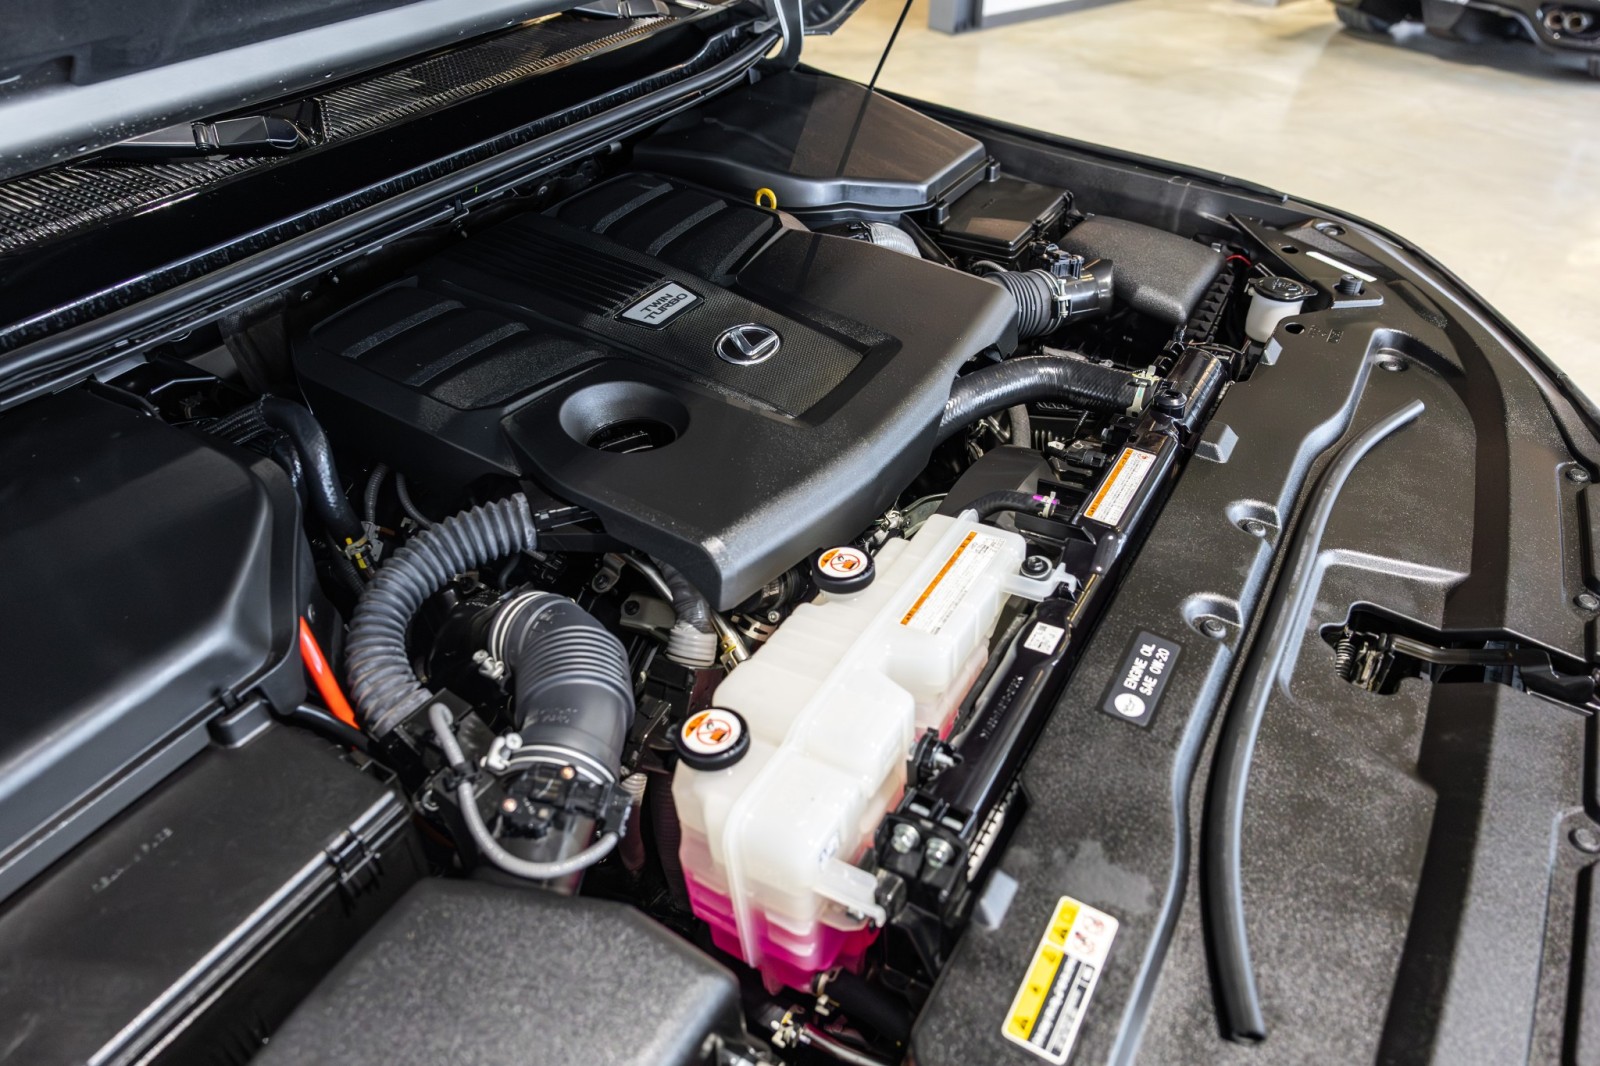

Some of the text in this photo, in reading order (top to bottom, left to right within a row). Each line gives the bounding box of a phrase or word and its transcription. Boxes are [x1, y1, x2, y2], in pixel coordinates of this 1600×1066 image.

[641, 293, 673, 312] TWIN
[644, 293, 688, 319] TURBO
[1123, 657, 1148, 690] ENGINE
[1139, 648, 1170, 696] SAE 0W-20
